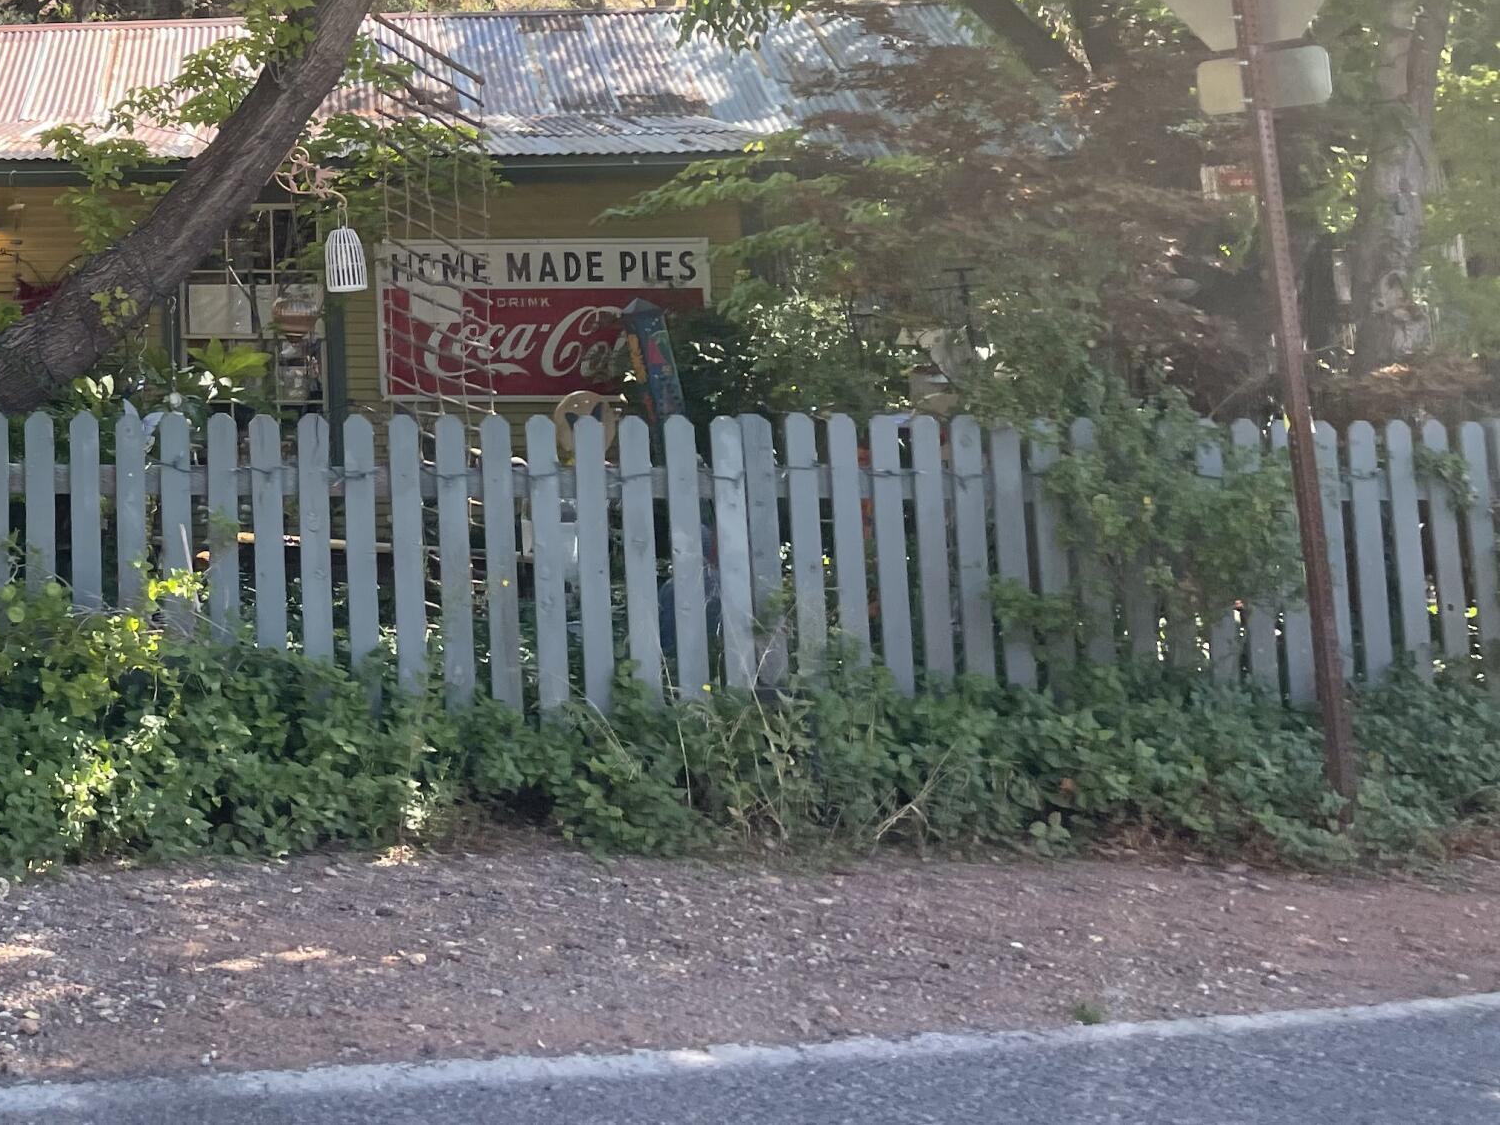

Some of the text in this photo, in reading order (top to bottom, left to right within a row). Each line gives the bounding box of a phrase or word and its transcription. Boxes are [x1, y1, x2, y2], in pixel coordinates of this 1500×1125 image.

[506, 250, 605, 283] MADE
[619, 250, 698, 283] PIES
[496, 296, 551, 309] DRINK
